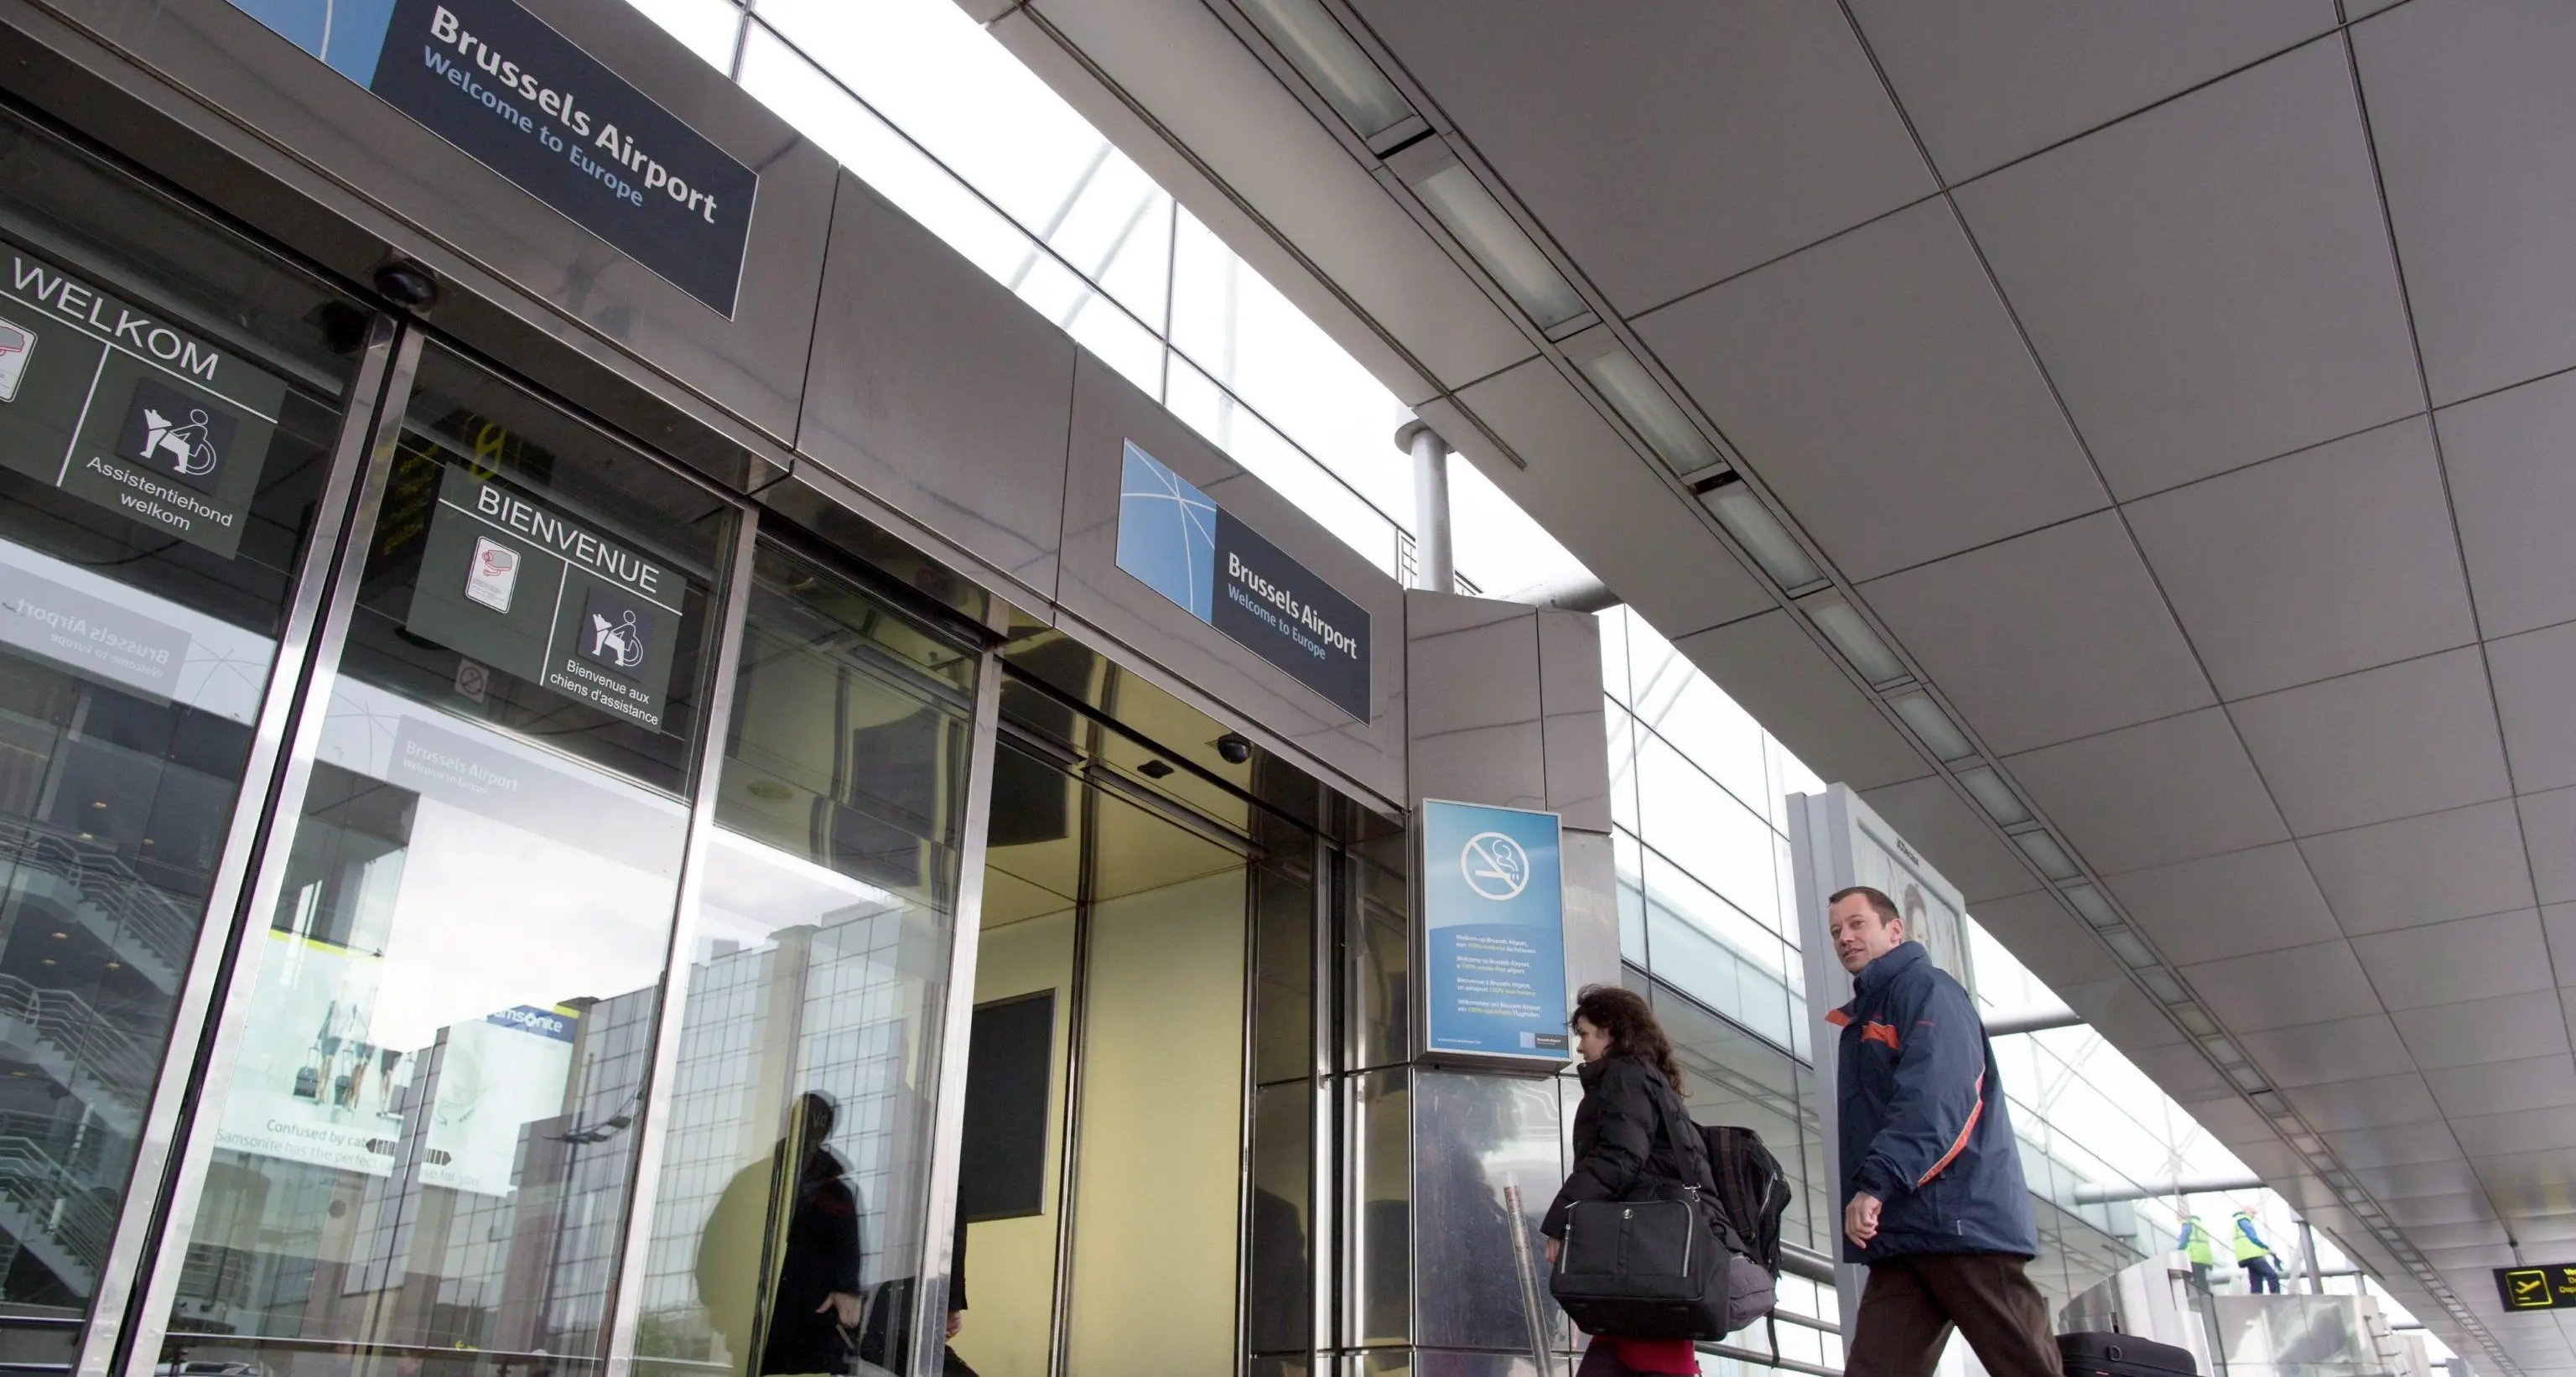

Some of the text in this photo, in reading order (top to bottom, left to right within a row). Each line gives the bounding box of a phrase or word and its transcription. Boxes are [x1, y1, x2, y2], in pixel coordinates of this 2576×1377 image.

[424, 44, 643, 207] Welcome to Europe
[430, 5, 718, 224] Brussels Airport
[14, 257, 219, 381] WELKOM
[86, 456, 233, 527] Assistentiehond
[121, 492, 190, 531] welkom
[477, 485, 660, 594] BIENVENUE
[1228, 552, 1357, 659] Brussels Airport
[1228, 583, 1326, 660] Welcome to Europe
[550, 673, 658, 725] chiens d'assistance
[566, 659, 650, 704] Bienvenue aux
[406, 740, 520, 792] Brussels Airport
[491, 1009, 564, 1033] amsonite
[216, 1130, 283, 1151] Samsonite
[285, 1141, 307, 1156] has
[310, 1146, 333, 1160] the
[267, 1119, 327, 1141] Confused
[330, 1130, 345, 1146] by
